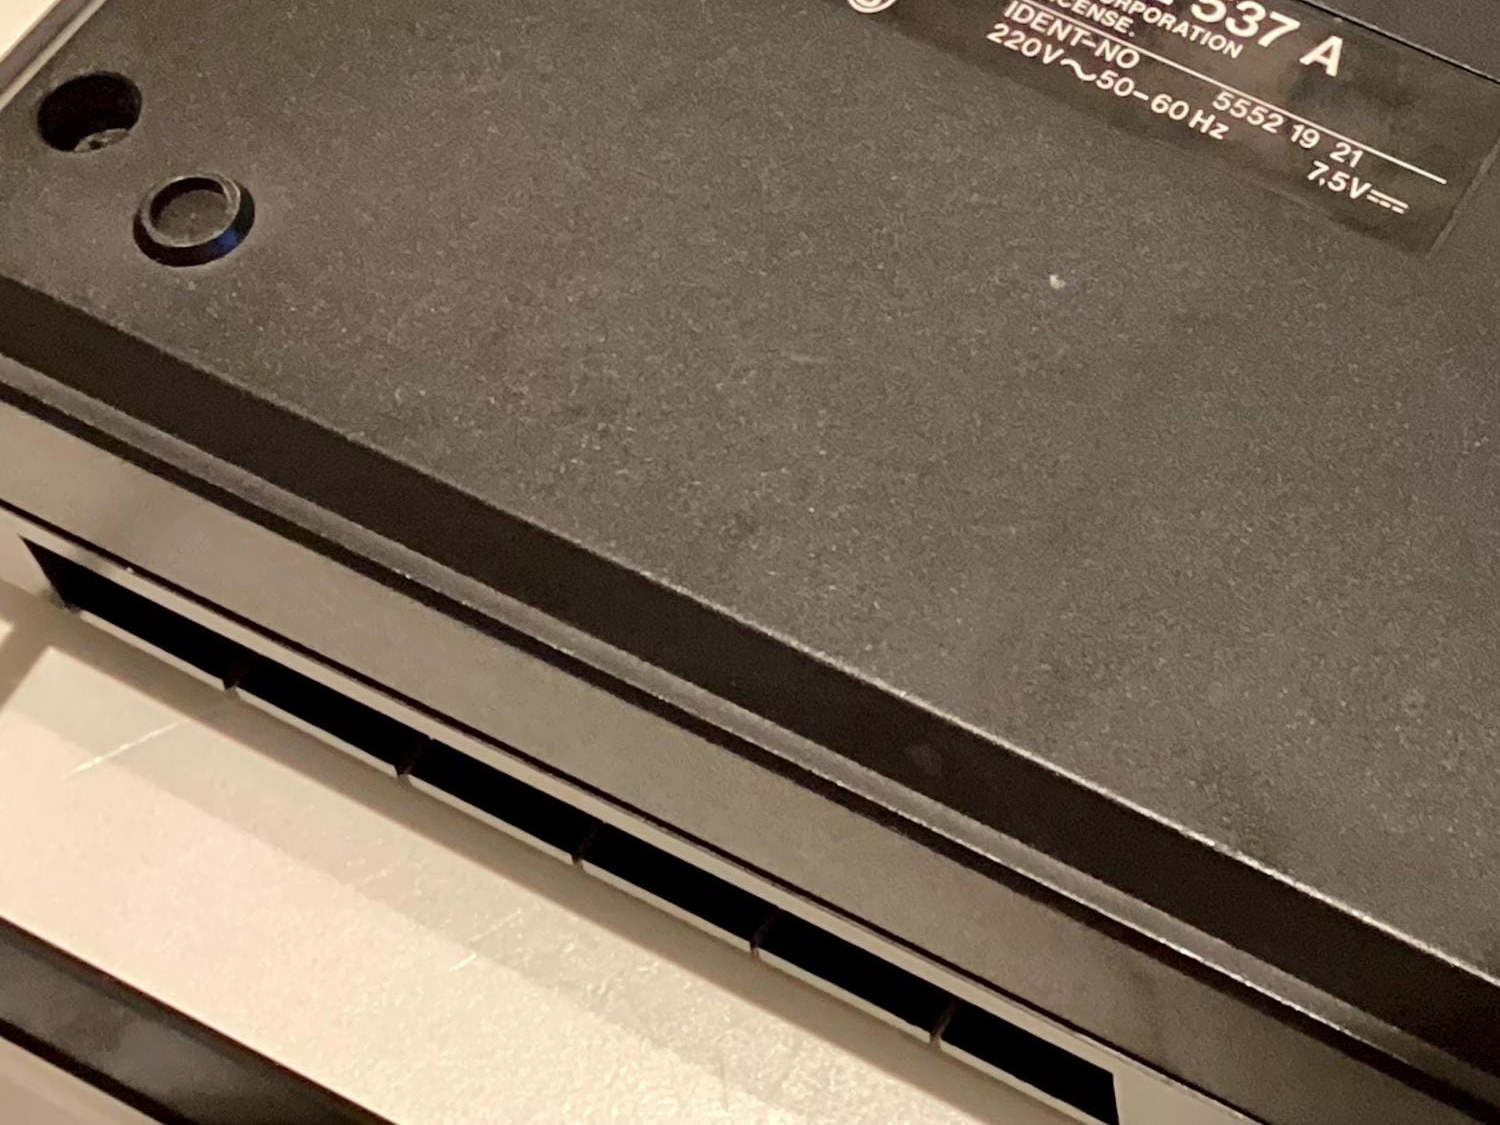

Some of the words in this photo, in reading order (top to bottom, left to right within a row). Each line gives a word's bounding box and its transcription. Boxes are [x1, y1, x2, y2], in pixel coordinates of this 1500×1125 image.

[1299, 35, 1343, 77] A
[1213, 91, 1284, 134] 5552
[1290, 124, 1320, 149] 19
[1329, 142, 1363, 168] 21
